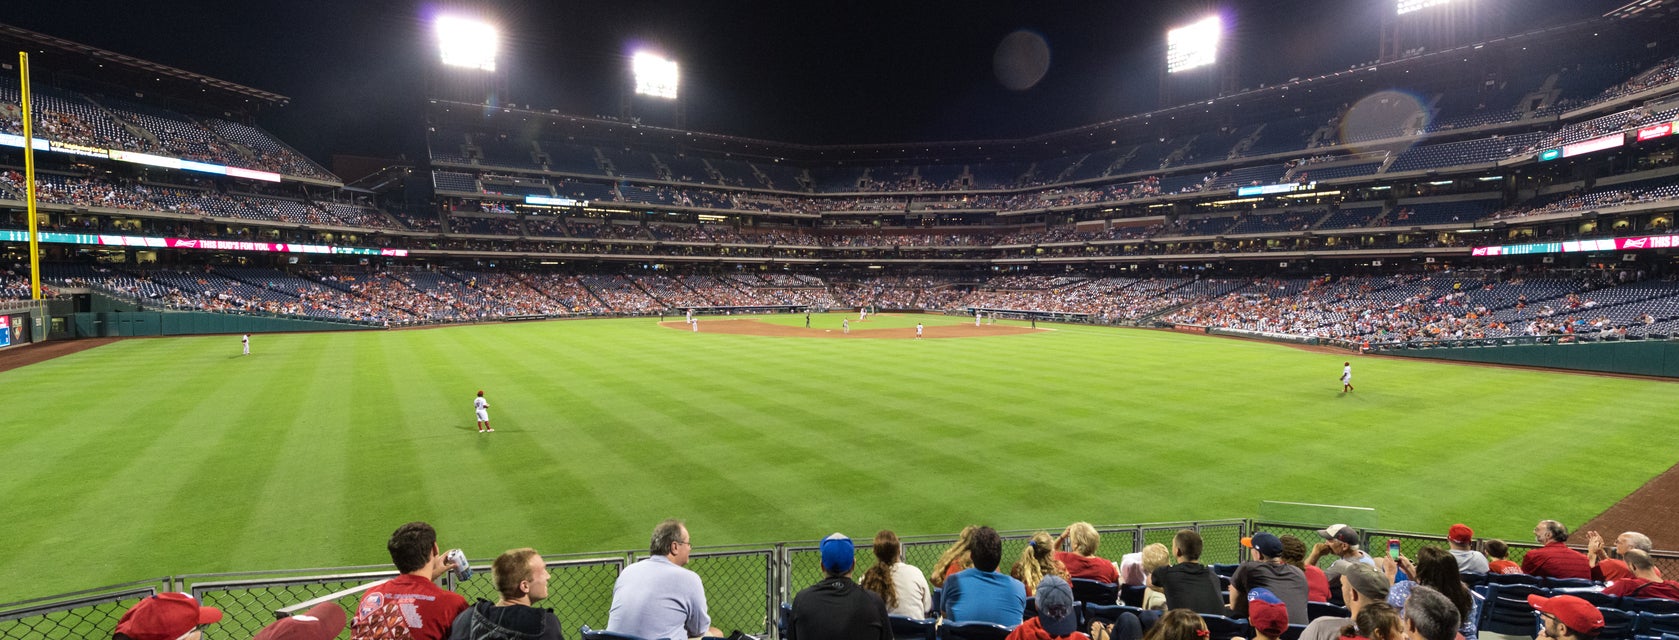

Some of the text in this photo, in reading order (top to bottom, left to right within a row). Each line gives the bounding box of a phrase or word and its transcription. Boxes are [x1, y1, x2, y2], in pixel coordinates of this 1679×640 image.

[199, 240, 217, 249] THIS
[218, 241, 239, 250] BUD'S
[240, 242, 254, 250] FOR
[254, 243, 270, 251] YOU.
[1650, 236, 1671, 248] THIS
